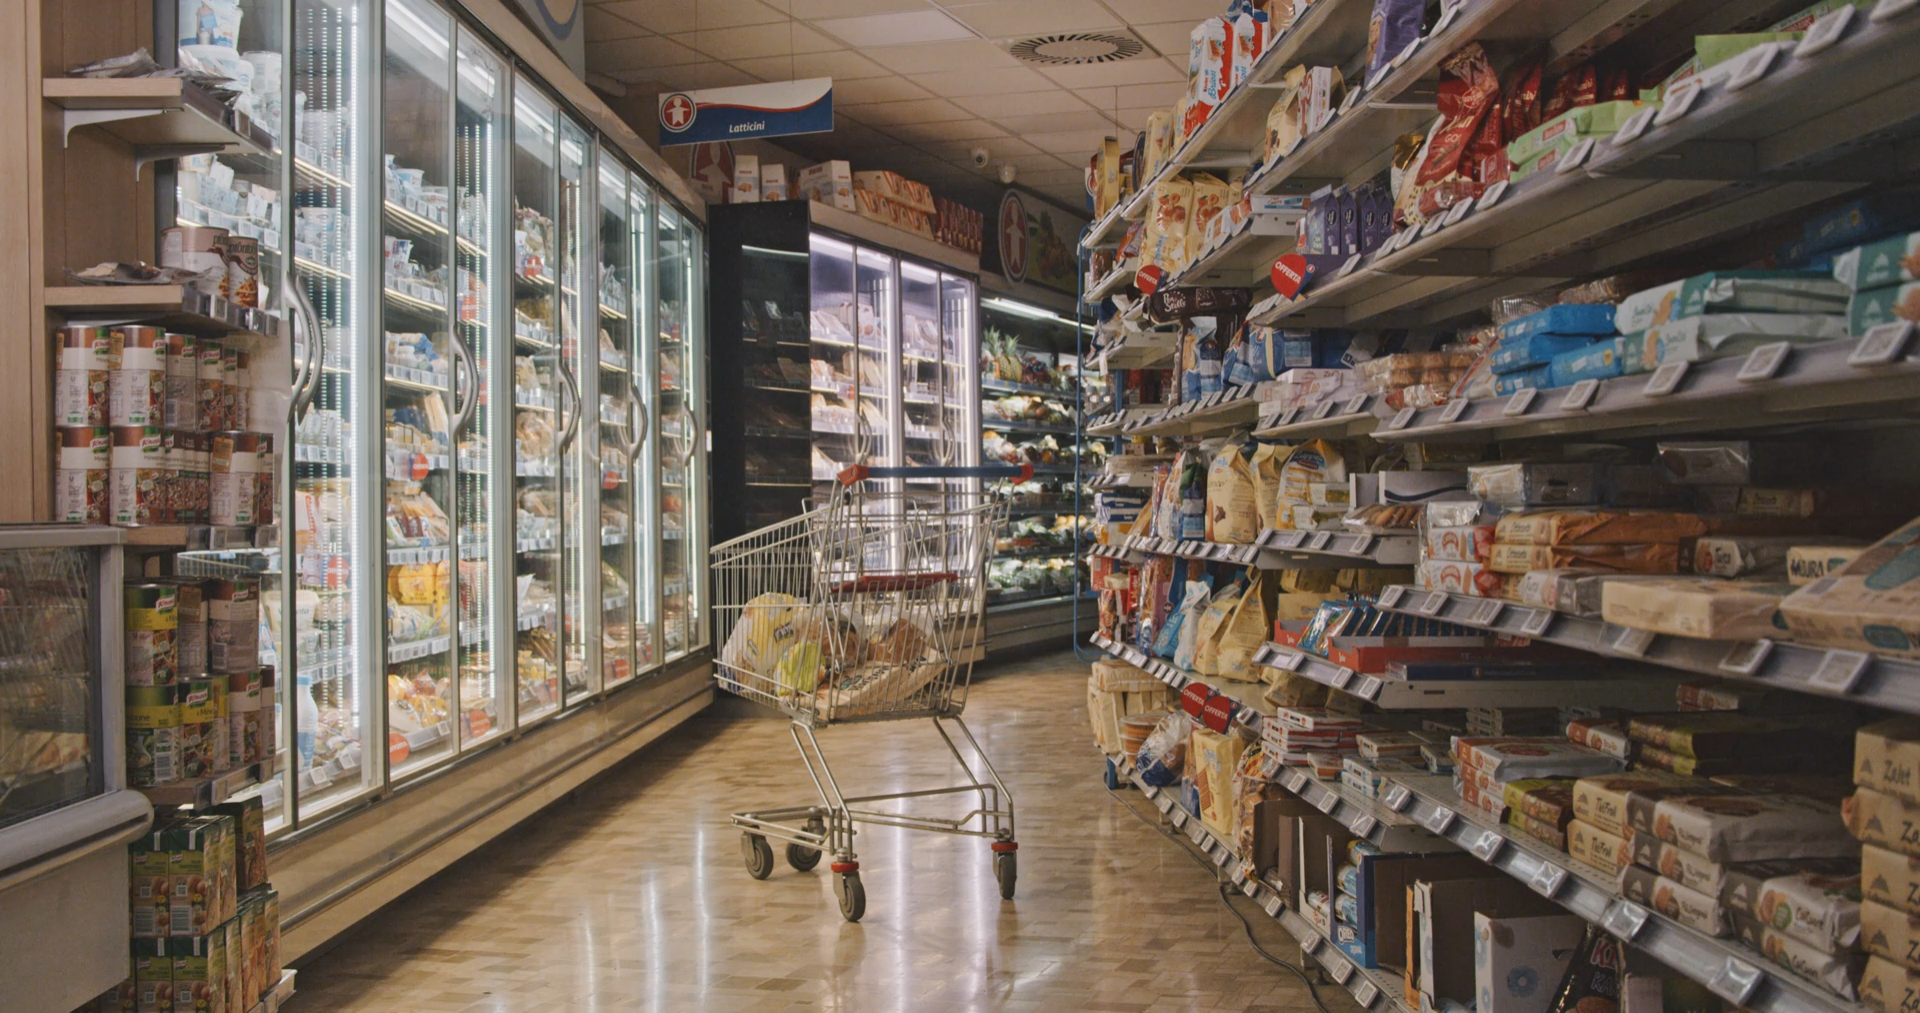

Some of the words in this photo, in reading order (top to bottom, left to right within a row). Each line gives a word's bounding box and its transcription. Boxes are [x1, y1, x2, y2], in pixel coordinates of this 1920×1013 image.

[728, 121, 765, 133] Latticini
[1138, 271, 1158, 285] OFFERTA
[1275, 261, 1302, 284] OFFERTA
[1183, 689, 1205, 706] OFFERTA
[1204, 705, 1228, 720] OFFERTA
